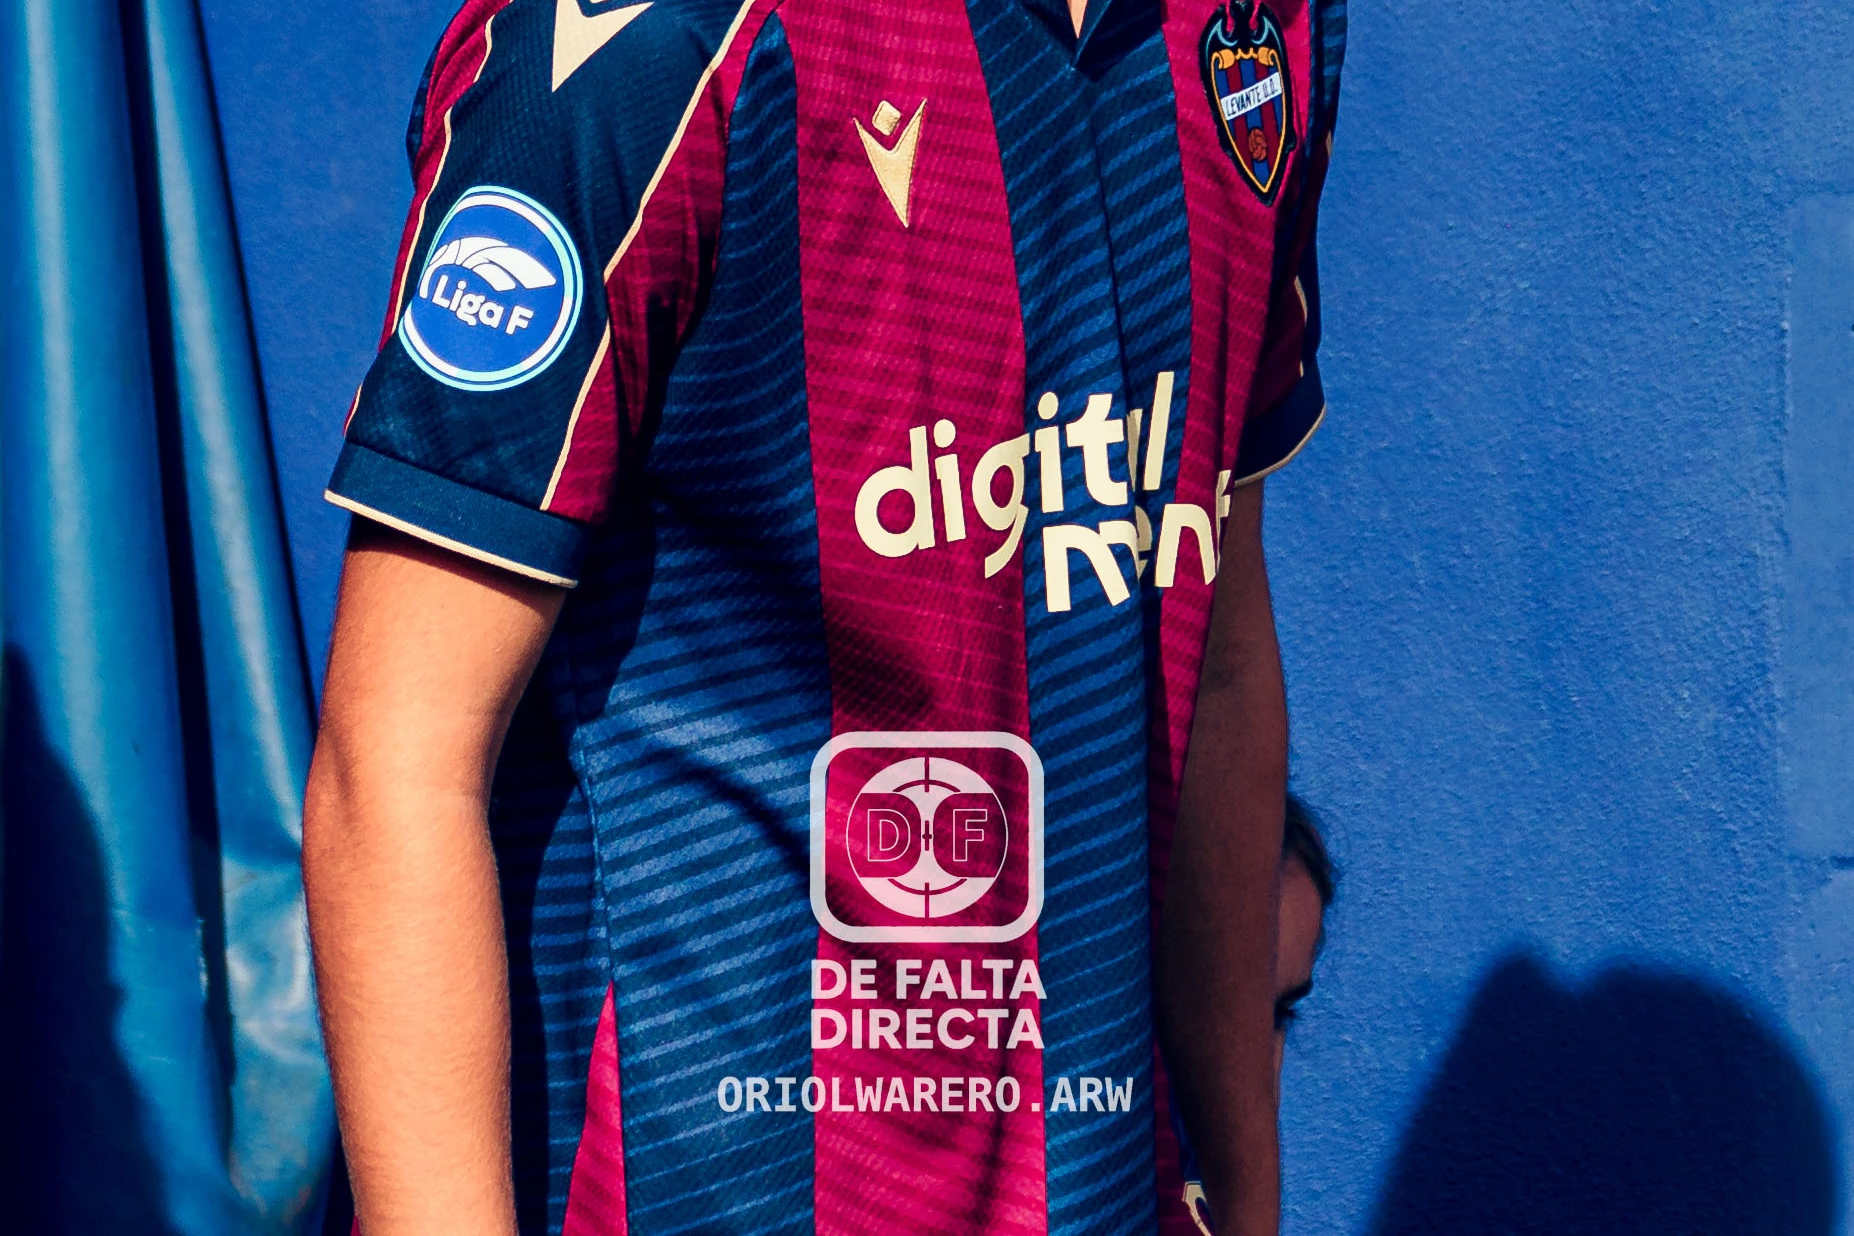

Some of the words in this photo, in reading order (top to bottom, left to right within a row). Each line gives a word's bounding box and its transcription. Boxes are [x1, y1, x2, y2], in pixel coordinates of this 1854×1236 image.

[1225, 86, 1262, 117] LEVANTE
[431, 274, 505, 329] Liga
[505, 305, 534, 335] F
[854, 370, 1175, 579] digitl
